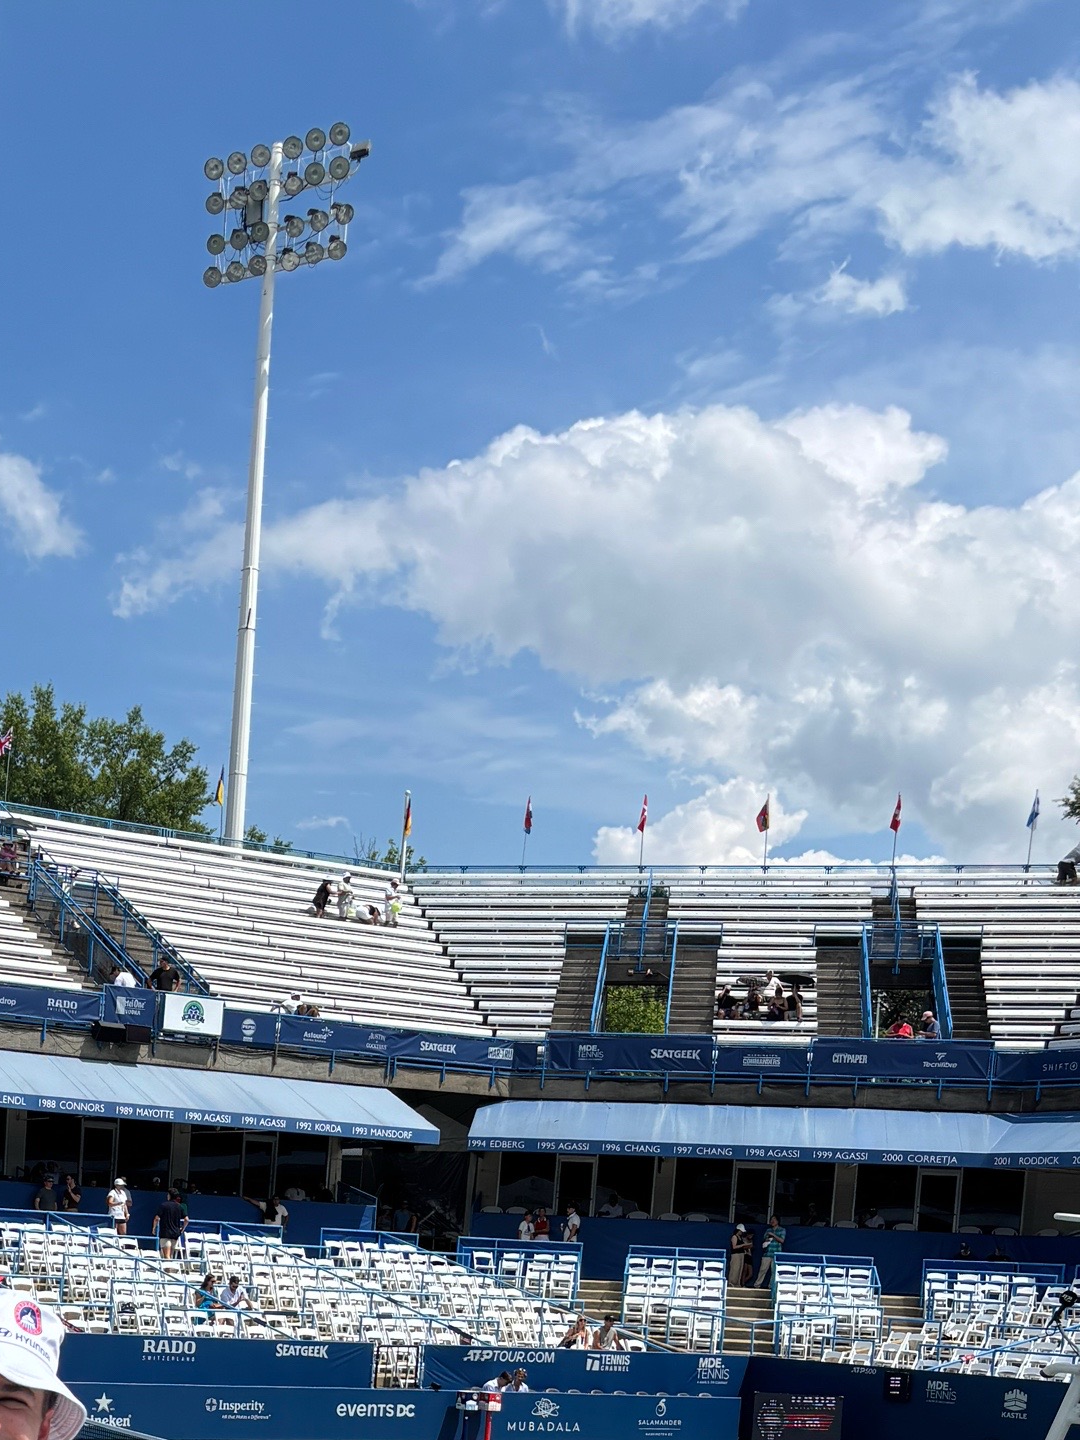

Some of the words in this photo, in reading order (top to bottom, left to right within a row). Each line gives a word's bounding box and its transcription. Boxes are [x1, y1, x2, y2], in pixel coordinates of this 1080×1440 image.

[47, 998, 78, 1010] RADO
[303, 1031, 327, 1040] Astound
[420, 1041, 457, 1055] SEATGEEK
[650, 1048, 701, 1060] SEATGEEK
[578, 1051, 604, 1059] TENNIS
[38, 1098, 56, 1109] 1988
[59, 1100, 105, 1113] CONNORS
[115, 1105, 133, 1116] 1989
[136, 1107, 175, 1120] MAYOTTE
[185, 1111, 203, 1121] 1990
[203, 1112, 232, 1124] AGASSI
[241, 1115, 258, 1125] 1991
[259, 1117, 287, 1128] AGASSI
[295, 1121, 312, 1131] 1992
[314, 1122, 342, 1133] KORDA
[352, 1126, 368, 1136] 1993
[370, 1128, 413, 1140] MANSDORF
[468, 1138, 486, 1148] 1994
[489, 1140, 525, 1149] EDBERG
[537, 1141, 556, 1150] 1995
[557, 1142, 590, 1151] AGASSI
[602, 1143, 621, 1152] 1996
[624, 1144, 661, 1154] CHANG
[673, 1145, 693, 1155] 1997
[696, 1146, 733, 1156] CHANG
[745, 1148, 764, 1158] 1998
[766, 1148, 800, 1158] AGASSI
[812, 1150, 833, 1160] 1999
[834, 1151, 868, 1161] AGASSI
[882, 1152, 903, 1162] 2000
[907, 1154, 958, 1166] CORRETJA
[993, 1156, 1011, 1166] 2001
[1018, 1155, 1059, 1165] RODDICK
[142, 1339, 197, 1355] RADO
[275, 1343, 329, 1359] SEATGEEK
[601, 1354, 631, 1366] TENNIS
[699, 1358, 725, 1369] MDE.
[696, 1368, 730, 1380] TENNIS
[927, 1380, 952, 1391] MDE.
[925, 1389, 957, 1401] TENNIS
[218, 1400, 265, 1414] Insperity
[85, 1413, 131, 1427] ineken
[1001, 1411, 1028, 1420] KASTLE
[507, 1421, 581, 1433] MUBADALA
